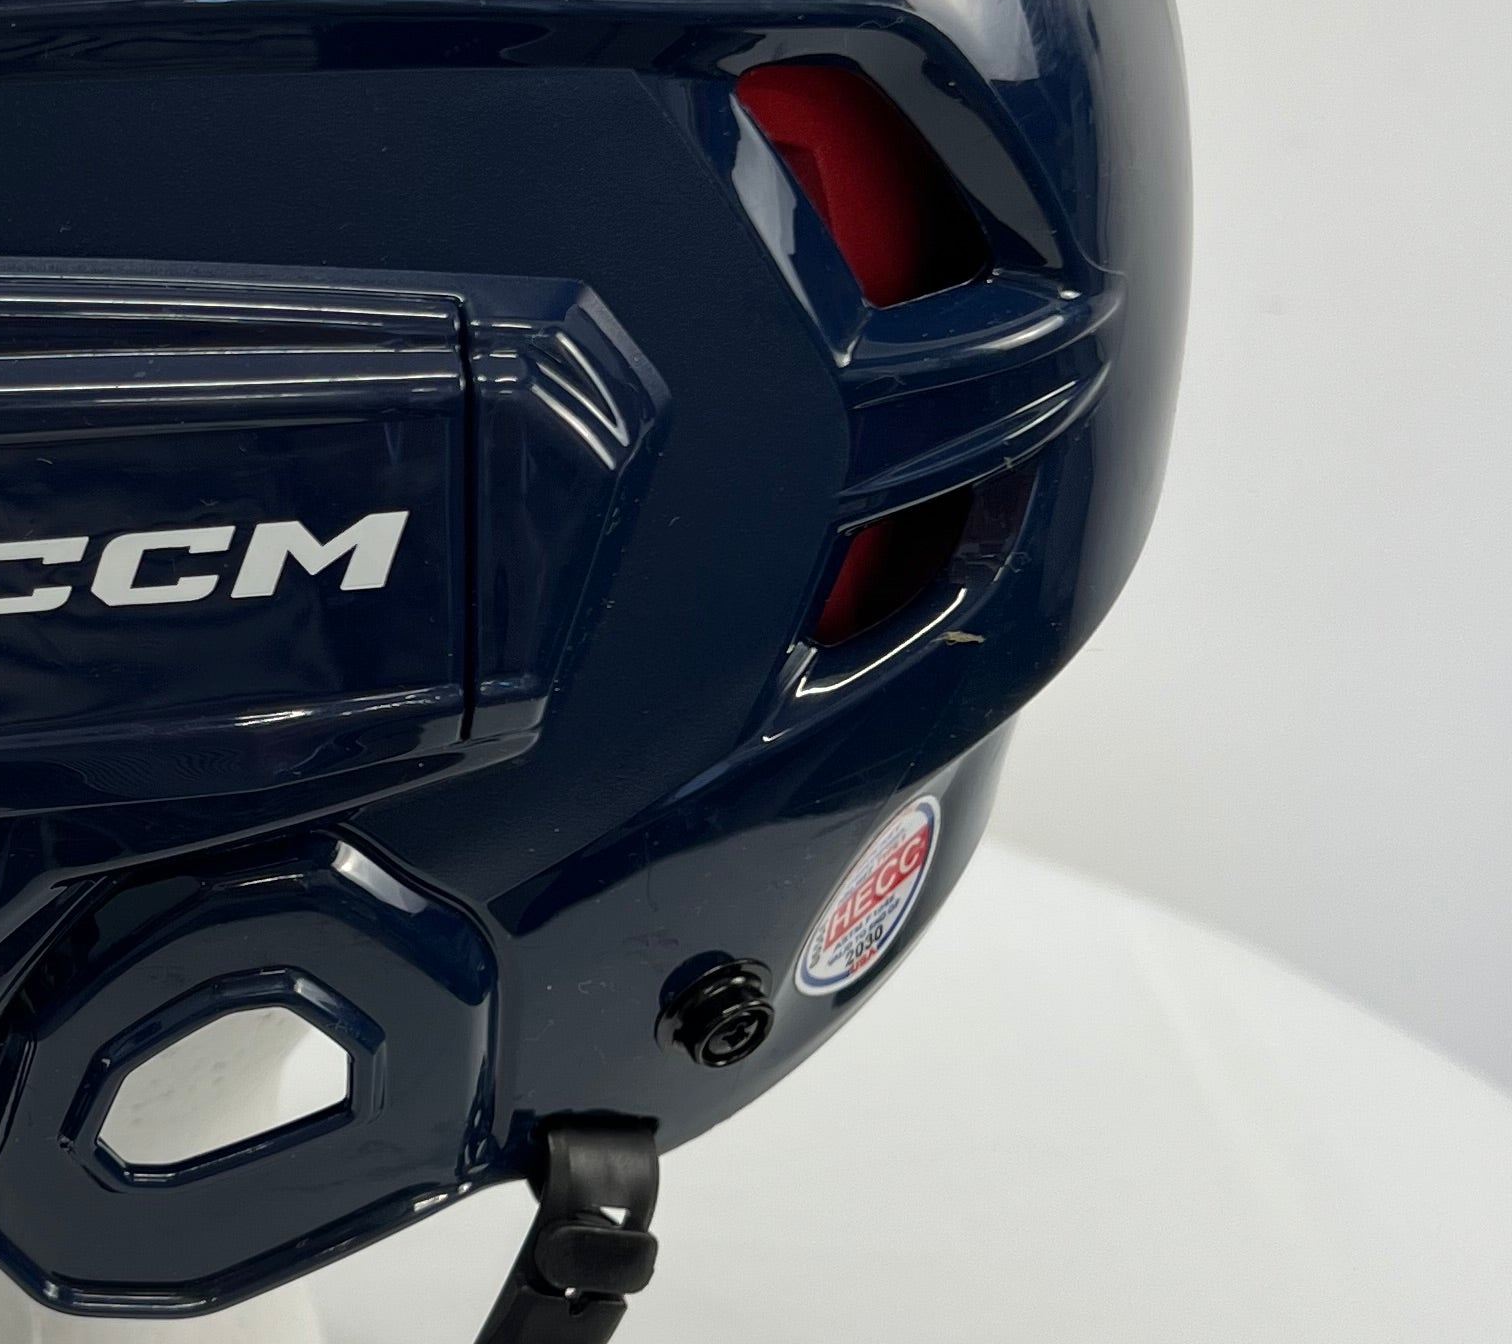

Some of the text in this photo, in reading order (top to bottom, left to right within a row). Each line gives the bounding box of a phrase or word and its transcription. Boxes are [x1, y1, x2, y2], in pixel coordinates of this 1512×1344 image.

[828, 836, 922, 941] HECC
[845, 924, 883, 968] 2030
[850, 947, 877, 973] USA
